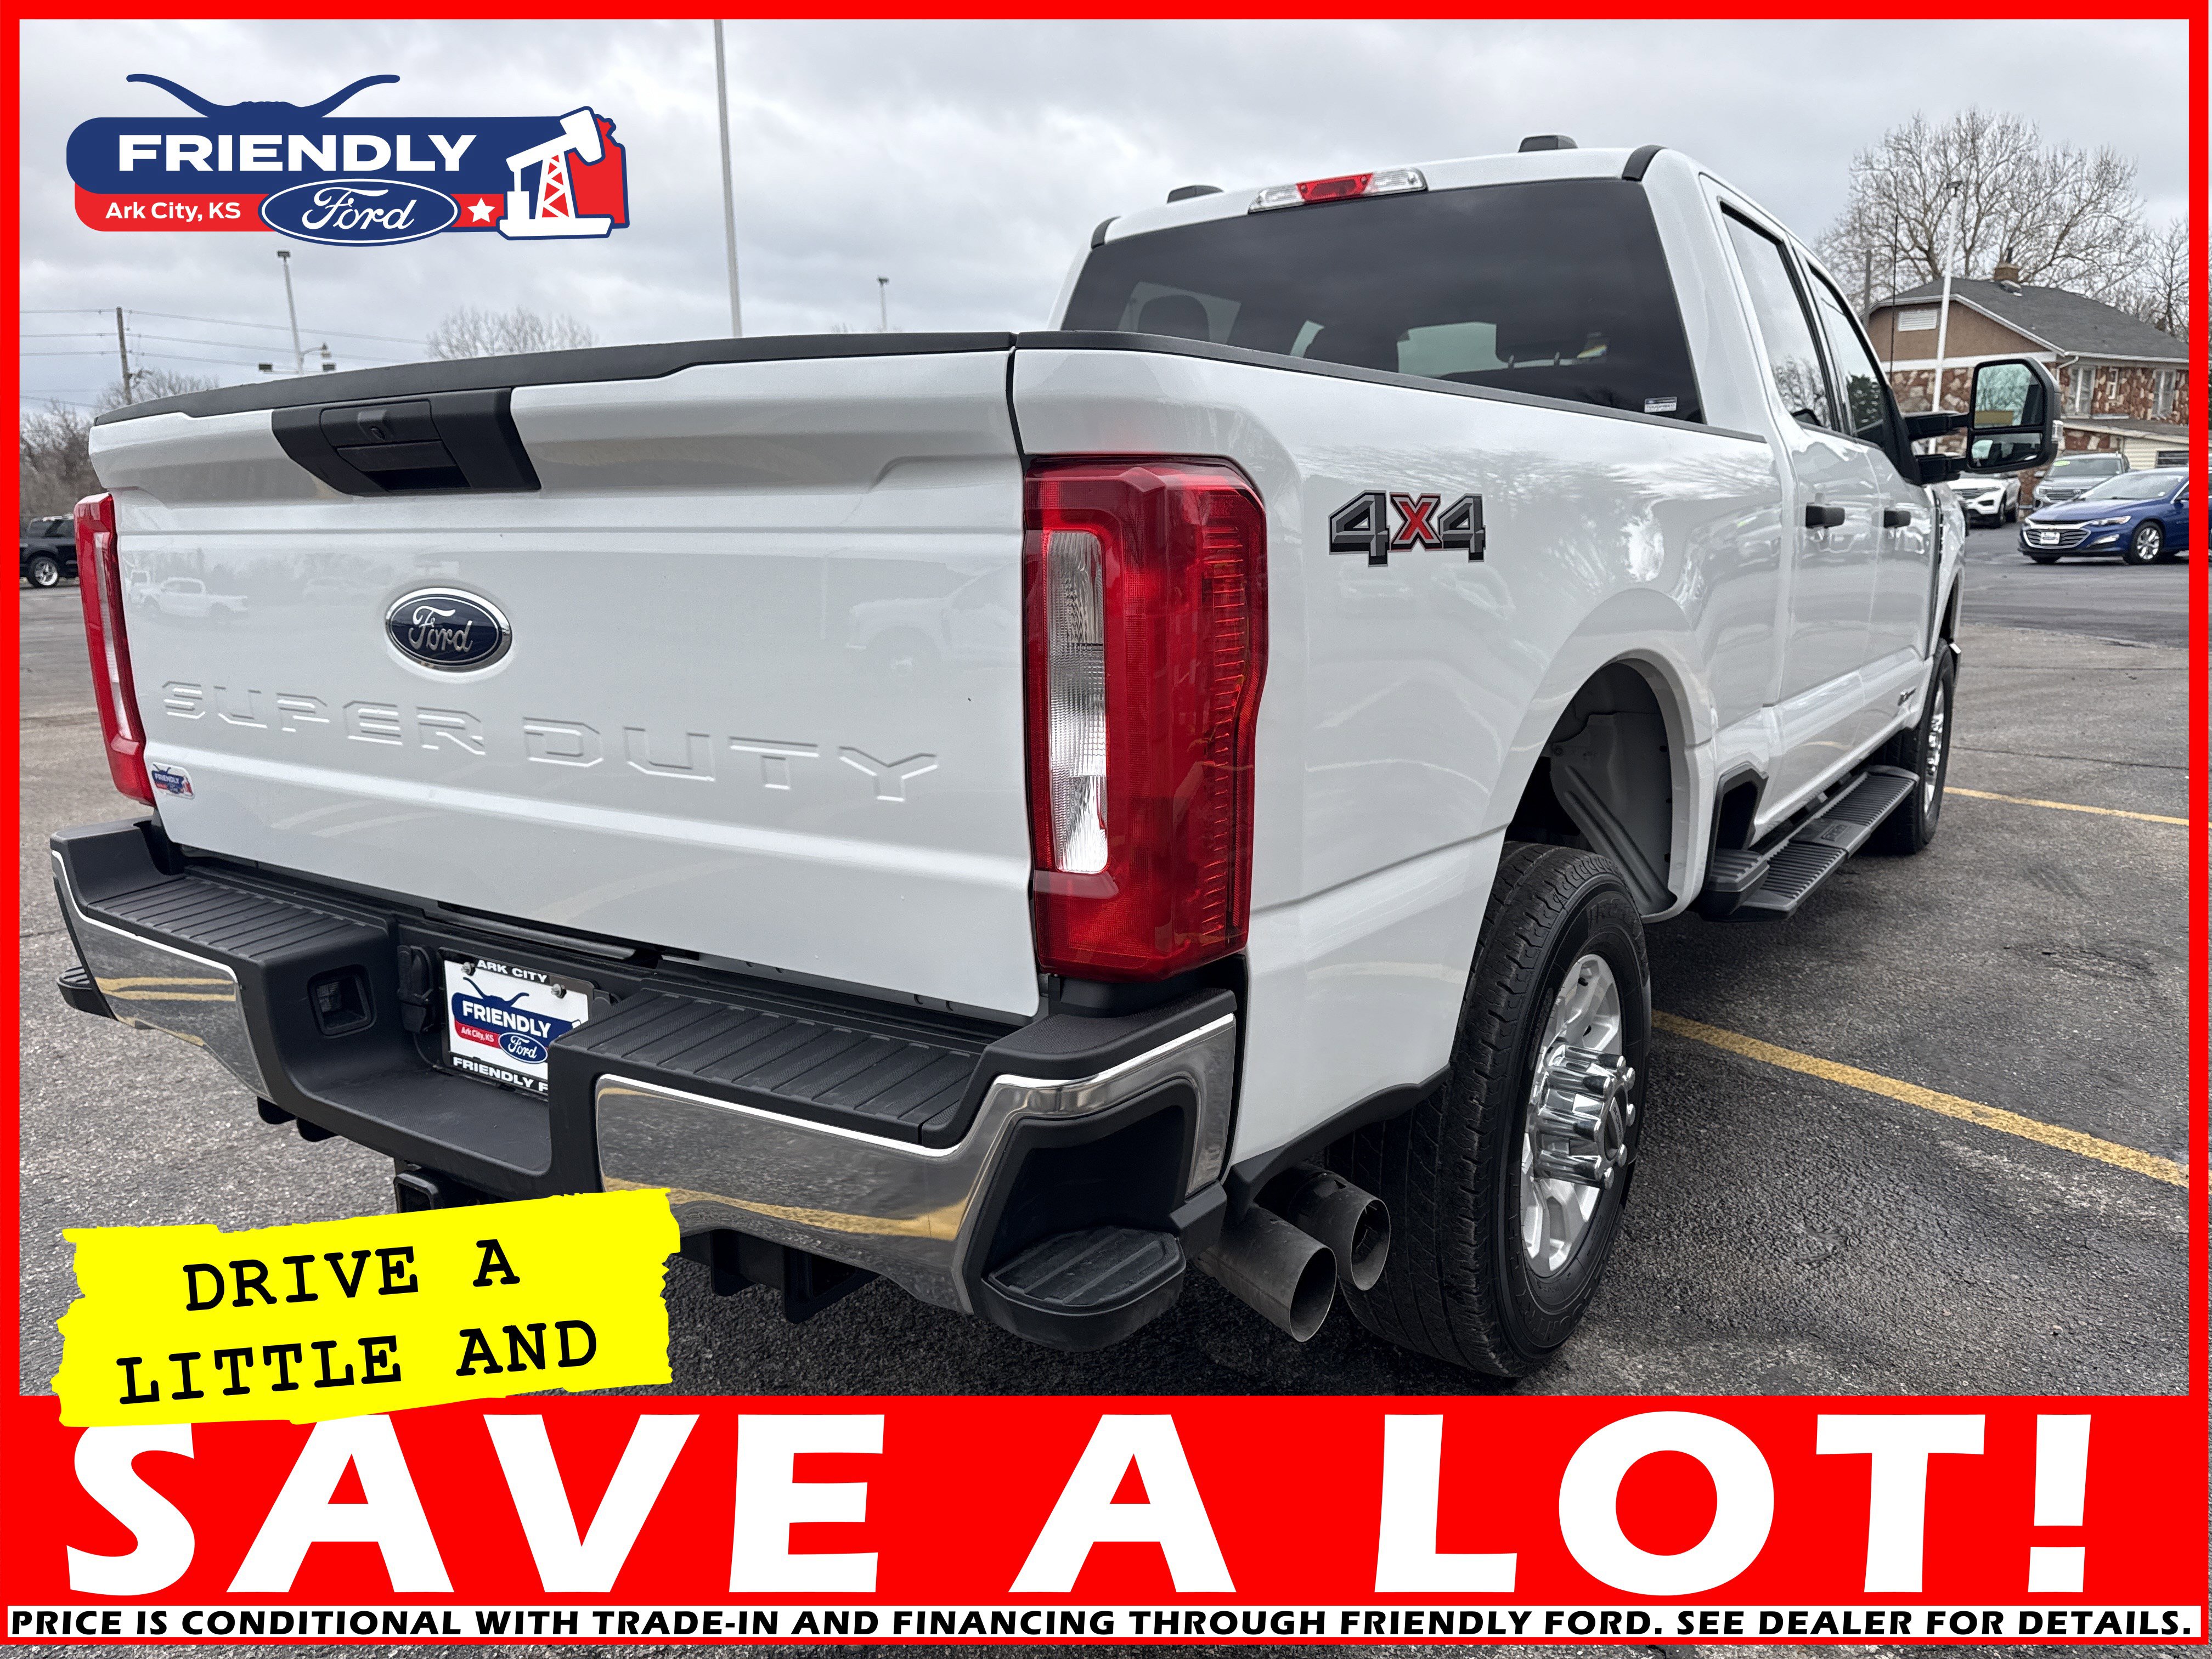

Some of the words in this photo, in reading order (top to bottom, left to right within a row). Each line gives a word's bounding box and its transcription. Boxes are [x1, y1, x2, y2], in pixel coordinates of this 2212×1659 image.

[408, 605, 473, 652] Ford
[162, 681, 486, 755] SUPER
[523, 717, 938, 801] DUTY
[477, 960, 508, 974] ARK
[512, 968, 548, 983] CITY
[461, 1026, 472, 1036] Ark
[485, 1032, 494, 1042] KS
[462, 1000, 551, 1038] FRIENDLY
[507, 1034, 538, 1059] Ford
[453, 1057, 534, 1088] FRIENDLY
